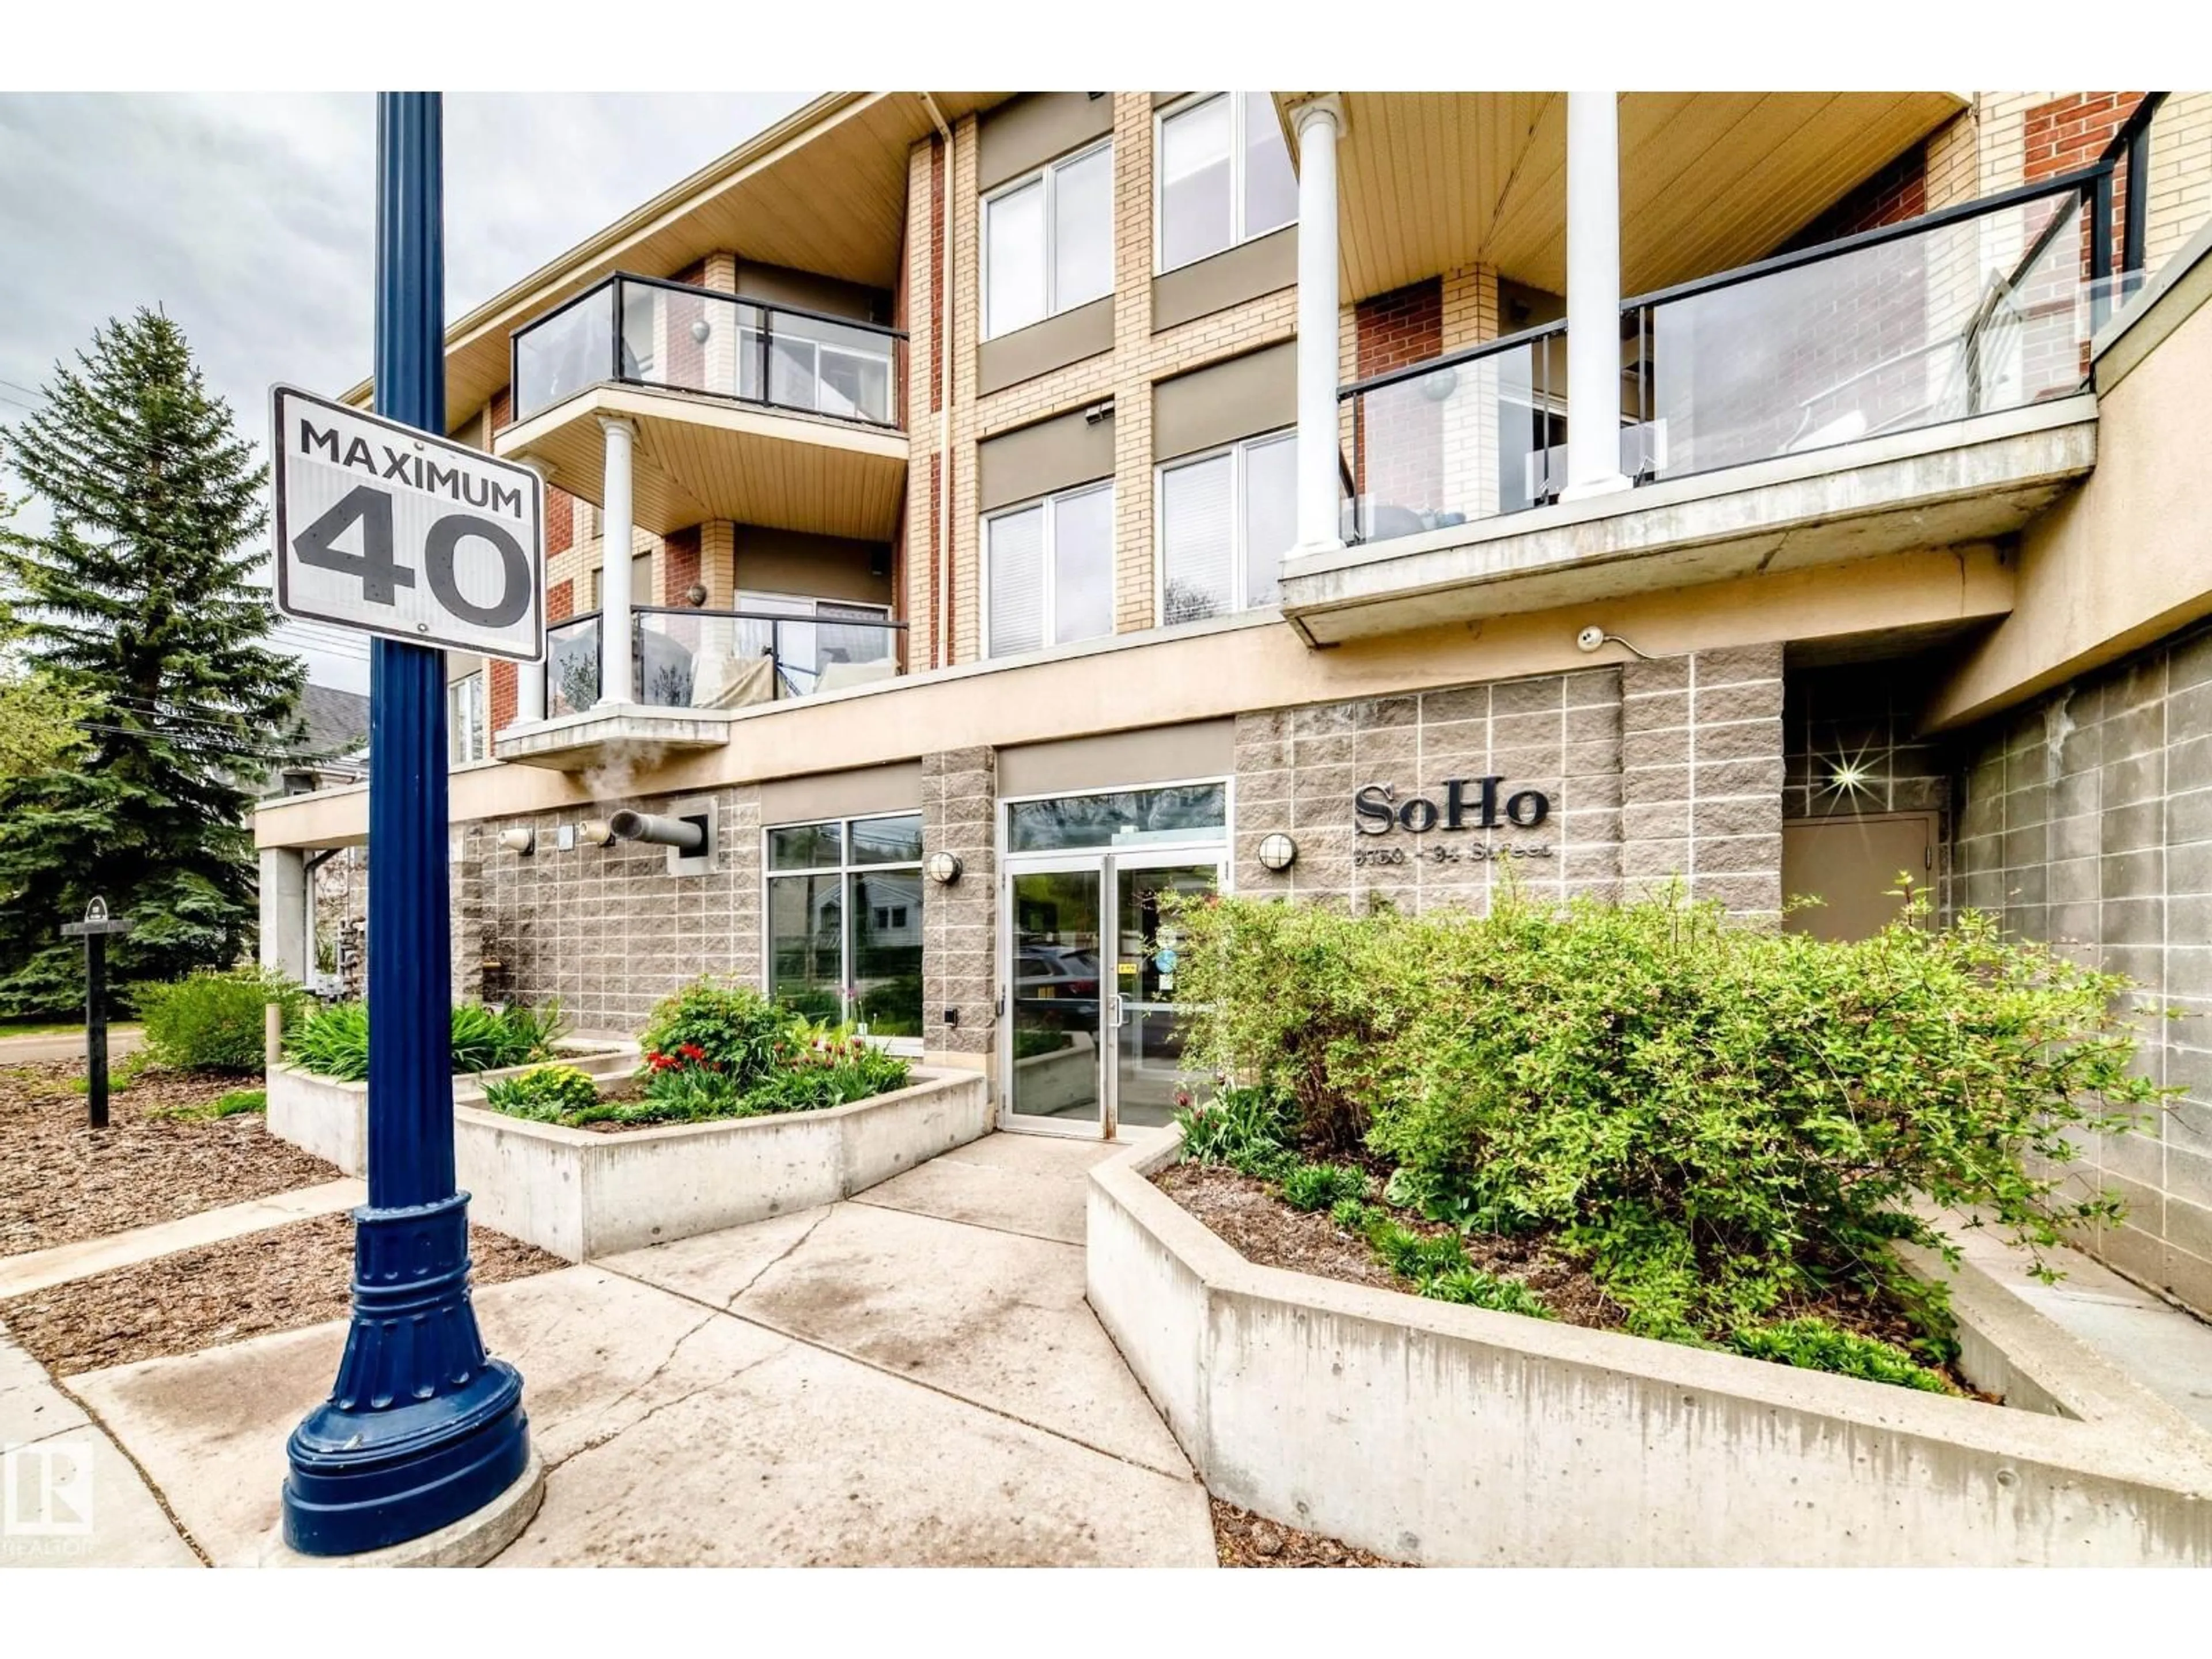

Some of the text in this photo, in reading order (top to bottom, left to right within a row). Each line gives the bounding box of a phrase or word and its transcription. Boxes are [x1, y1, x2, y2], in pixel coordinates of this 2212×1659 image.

[300, 418, 521, 518] MAXIMUM
[291, 484, 531, 628] 40
[1355, 775, 1550, 835] SoHo
